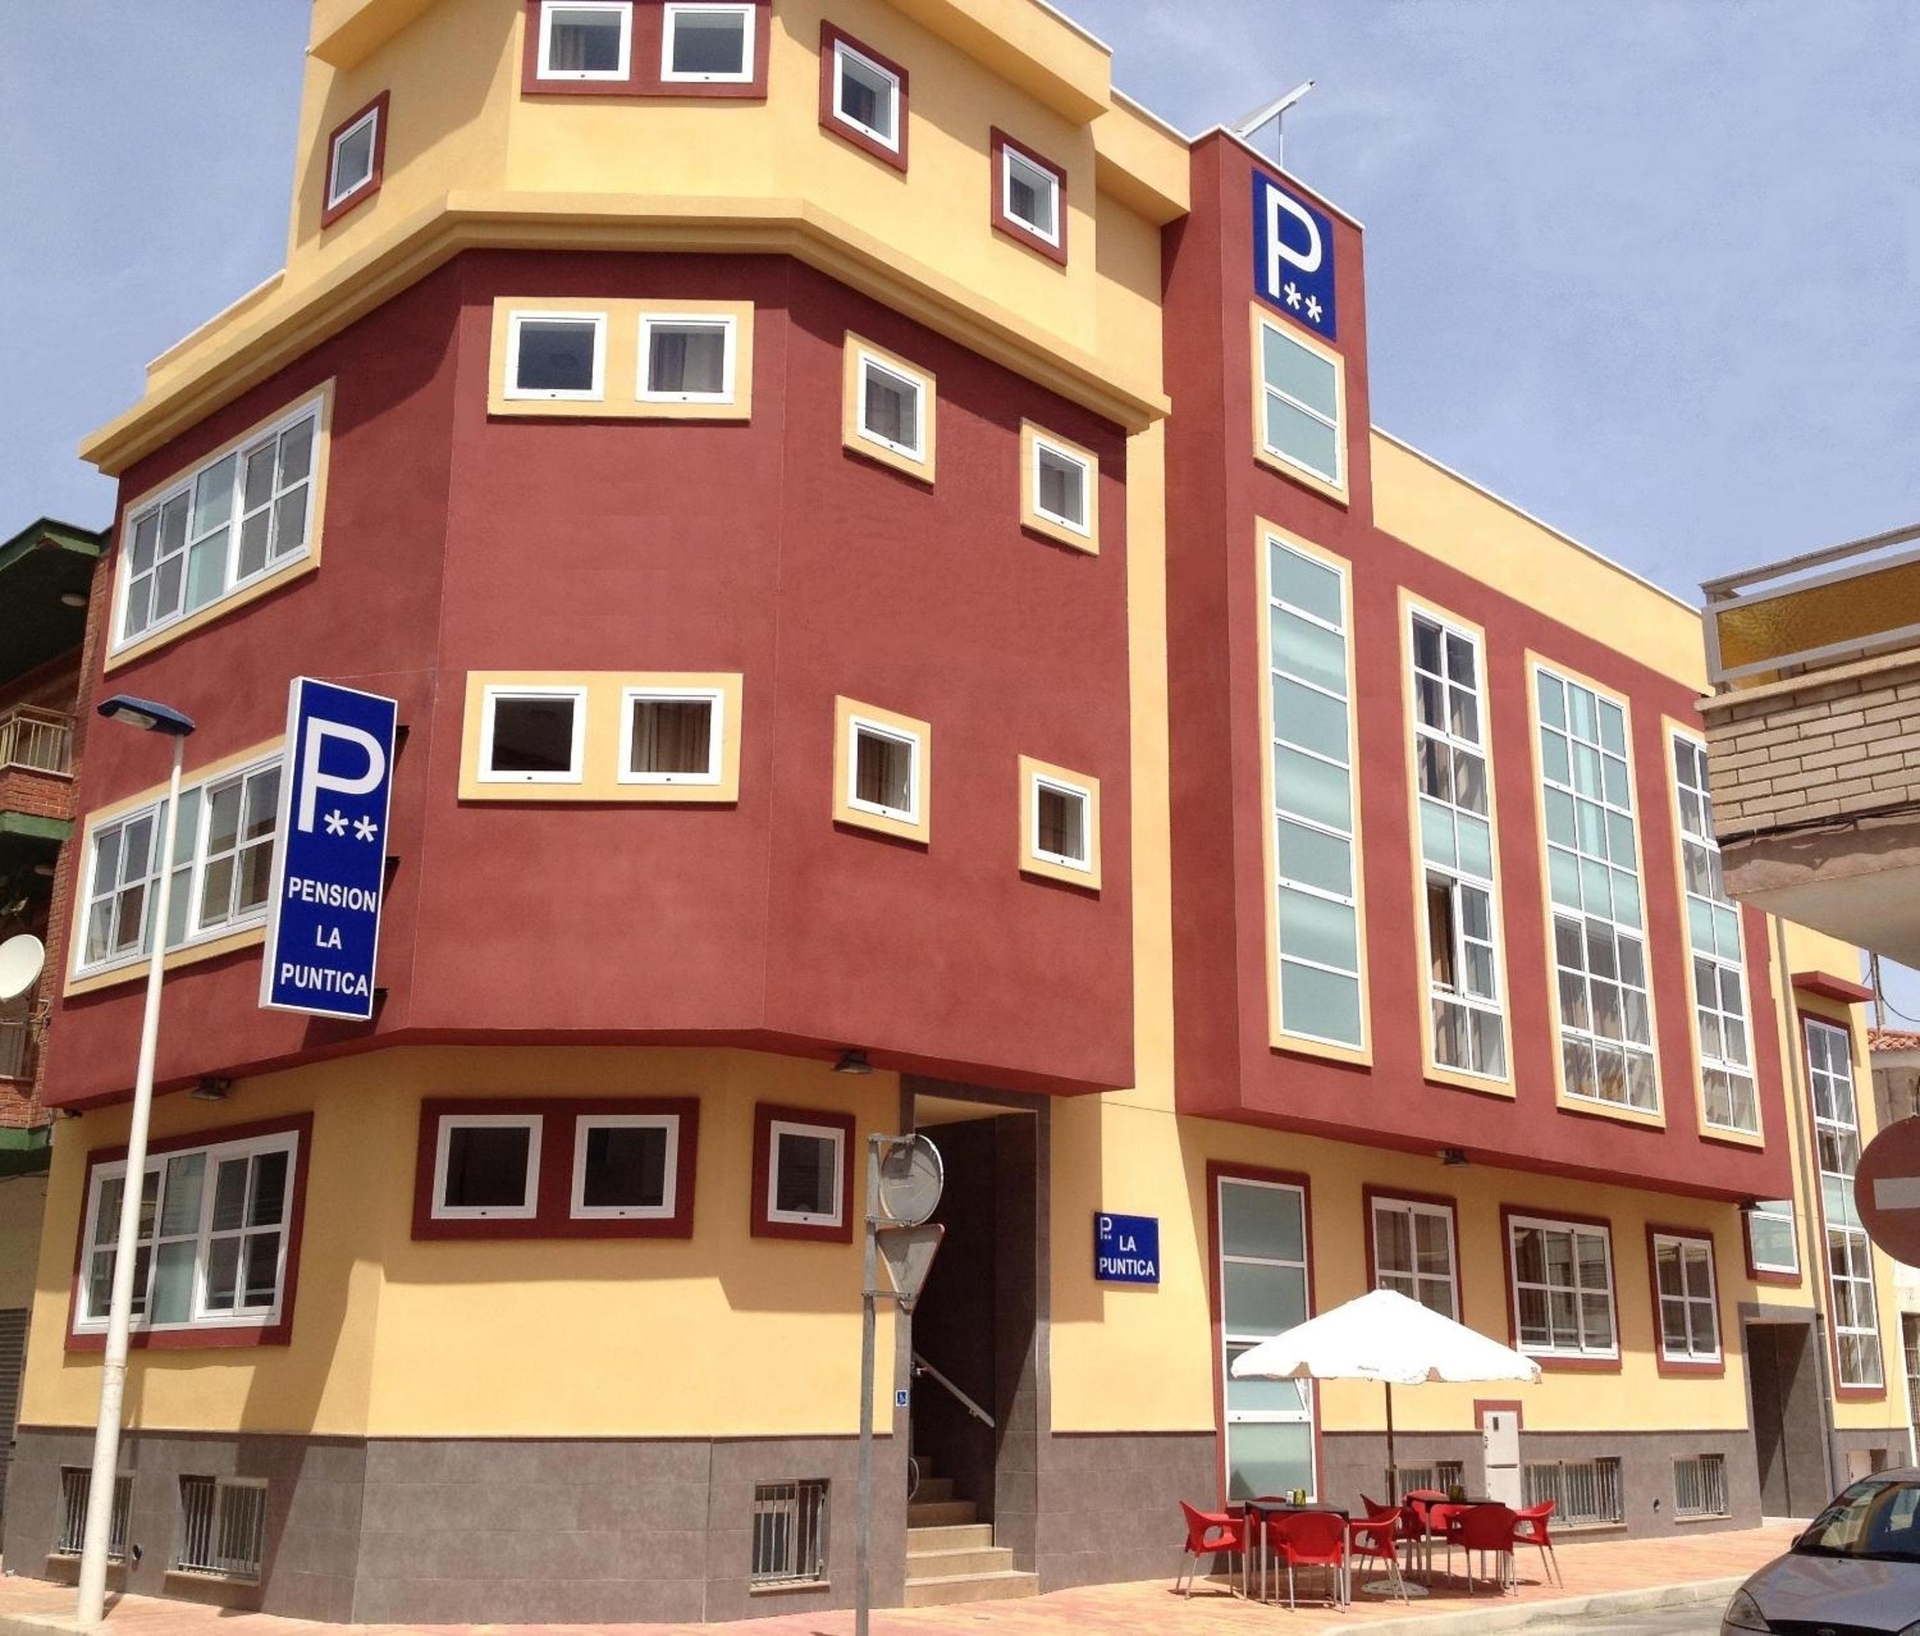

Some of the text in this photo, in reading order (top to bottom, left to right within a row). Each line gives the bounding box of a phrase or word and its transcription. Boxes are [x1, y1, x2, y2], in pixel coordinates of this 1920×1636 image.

[288, 876, 376, 913] PENSION
[316, 925, 342, 950] LA
[280, 963, 369, 998] PUNTICA
[1119, 1235, 1137, 1252] LA
[1099, 1257, 1156, 1276] PUNTICA
